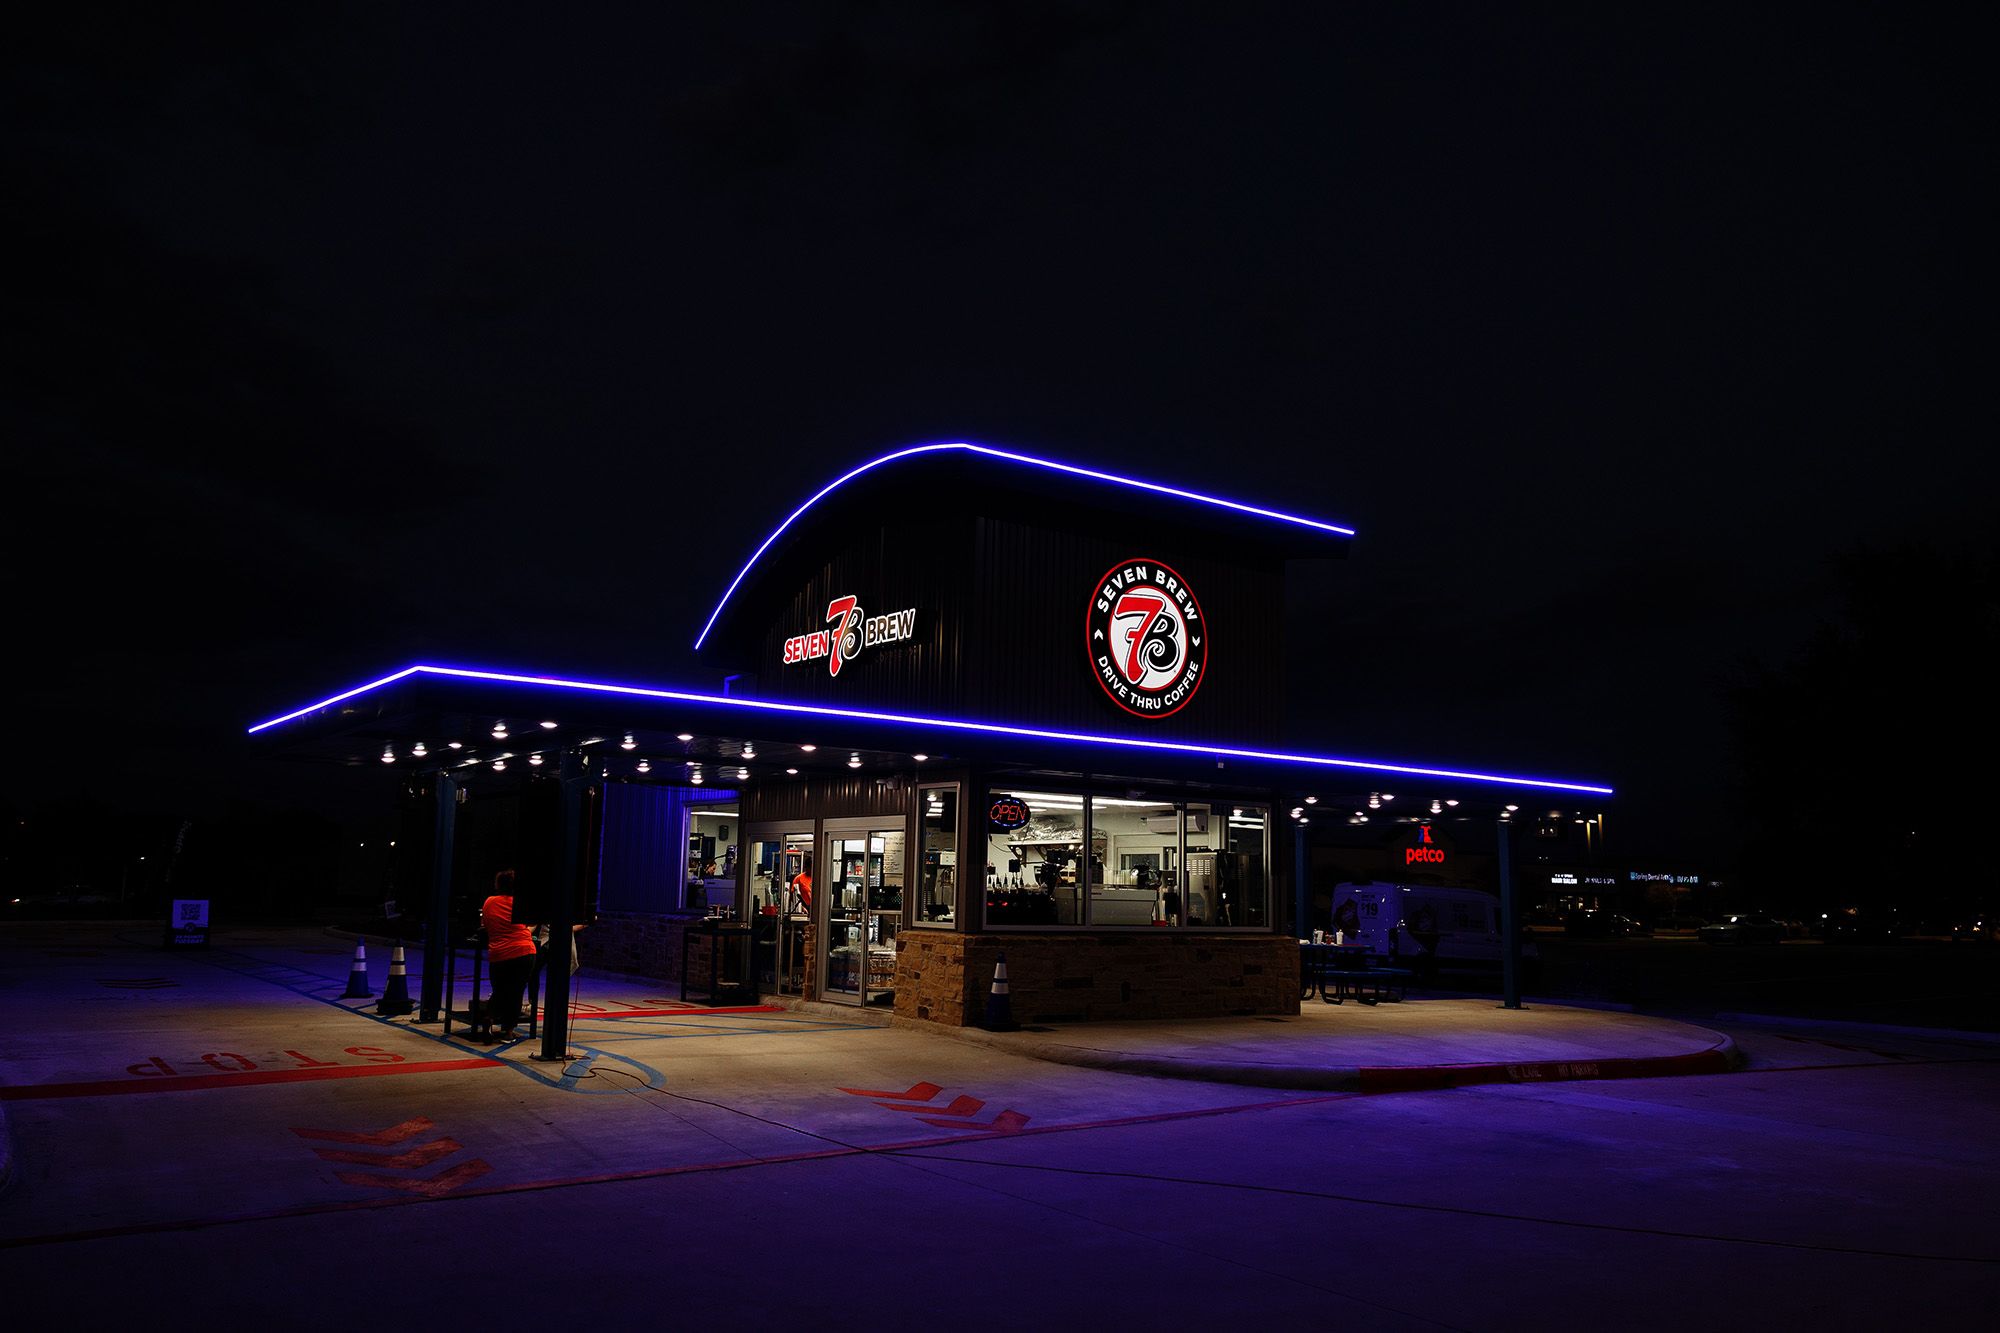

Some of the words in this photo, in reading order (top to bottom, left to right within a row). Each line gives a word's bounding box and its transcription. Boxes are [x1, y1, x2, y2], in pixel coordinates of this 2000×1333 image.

[1097, 566, 1148, 613] SEVEN
[1155, 569, 1198, 621] BREW
[783, 630, 830, 664] SEVEN
[865, 608, 916, 647] BREW
[1098, 655, 1128, 698] DRIVE
[1130, 692, 1161, 710] THRU
[1164, 660, 1199, 706] COFFEE
[990, 804, 1026, 821] OPEN
[1406, 846, 1445, 865] petco
[126, 1047, 406, 1077] STOP
